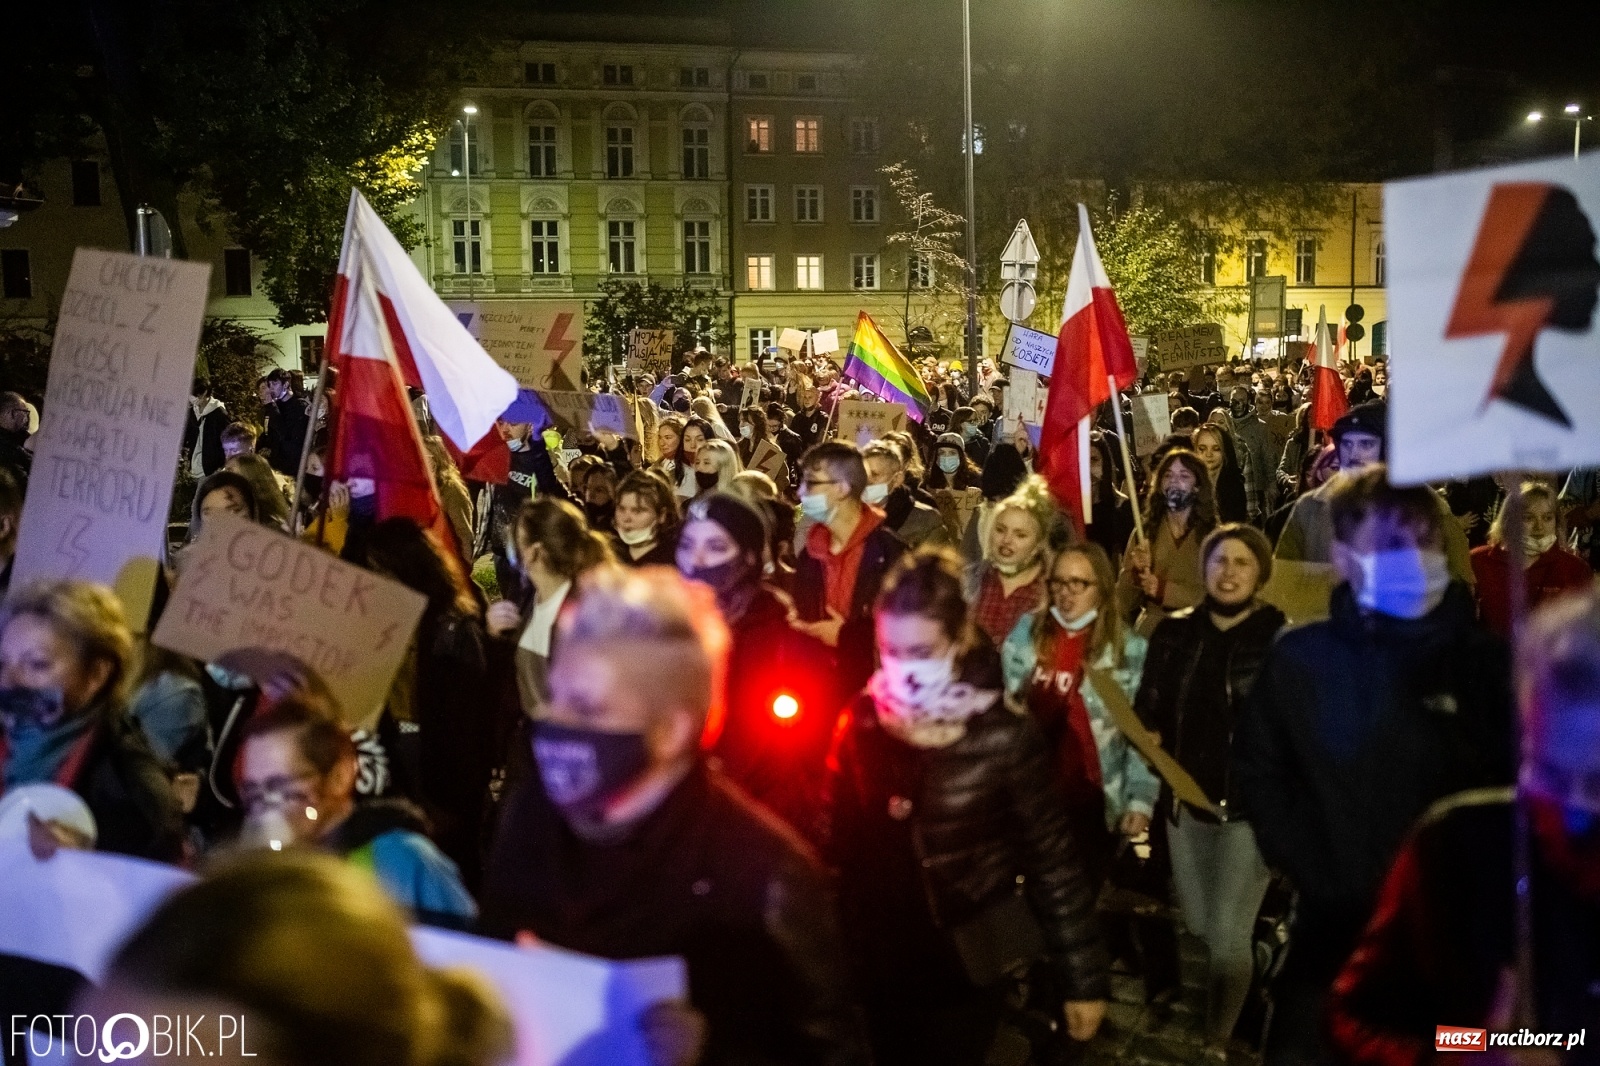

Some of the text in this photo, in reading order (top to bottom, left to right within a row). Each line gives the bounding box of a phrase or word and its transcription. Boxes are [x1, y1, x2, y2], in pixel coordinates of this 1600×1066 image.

[99, 258, 176, 293] CHCEMY
[138, 302, 161, 334] Z
[634, 331, 657, 345] MOJA
[1023, 330, 1043, 341] WARA
[1161, 327, 1214, 342] REAL MEN
[1174, 339, 1201, 353] ARE
[629, 342, 672, 360] PUSIA NIE
[1011, 346, 1049, 368] KOBIET!
[1026, 341, 1054, 356] NASZYCH
[140, 393, 174, 428] NIE
[51, 455, 159, 523] TERRORU
[227, 529, 375, 616] GODEK
[229, 575, 294, 621] WAS
[184, 597, 230, 636] THE
